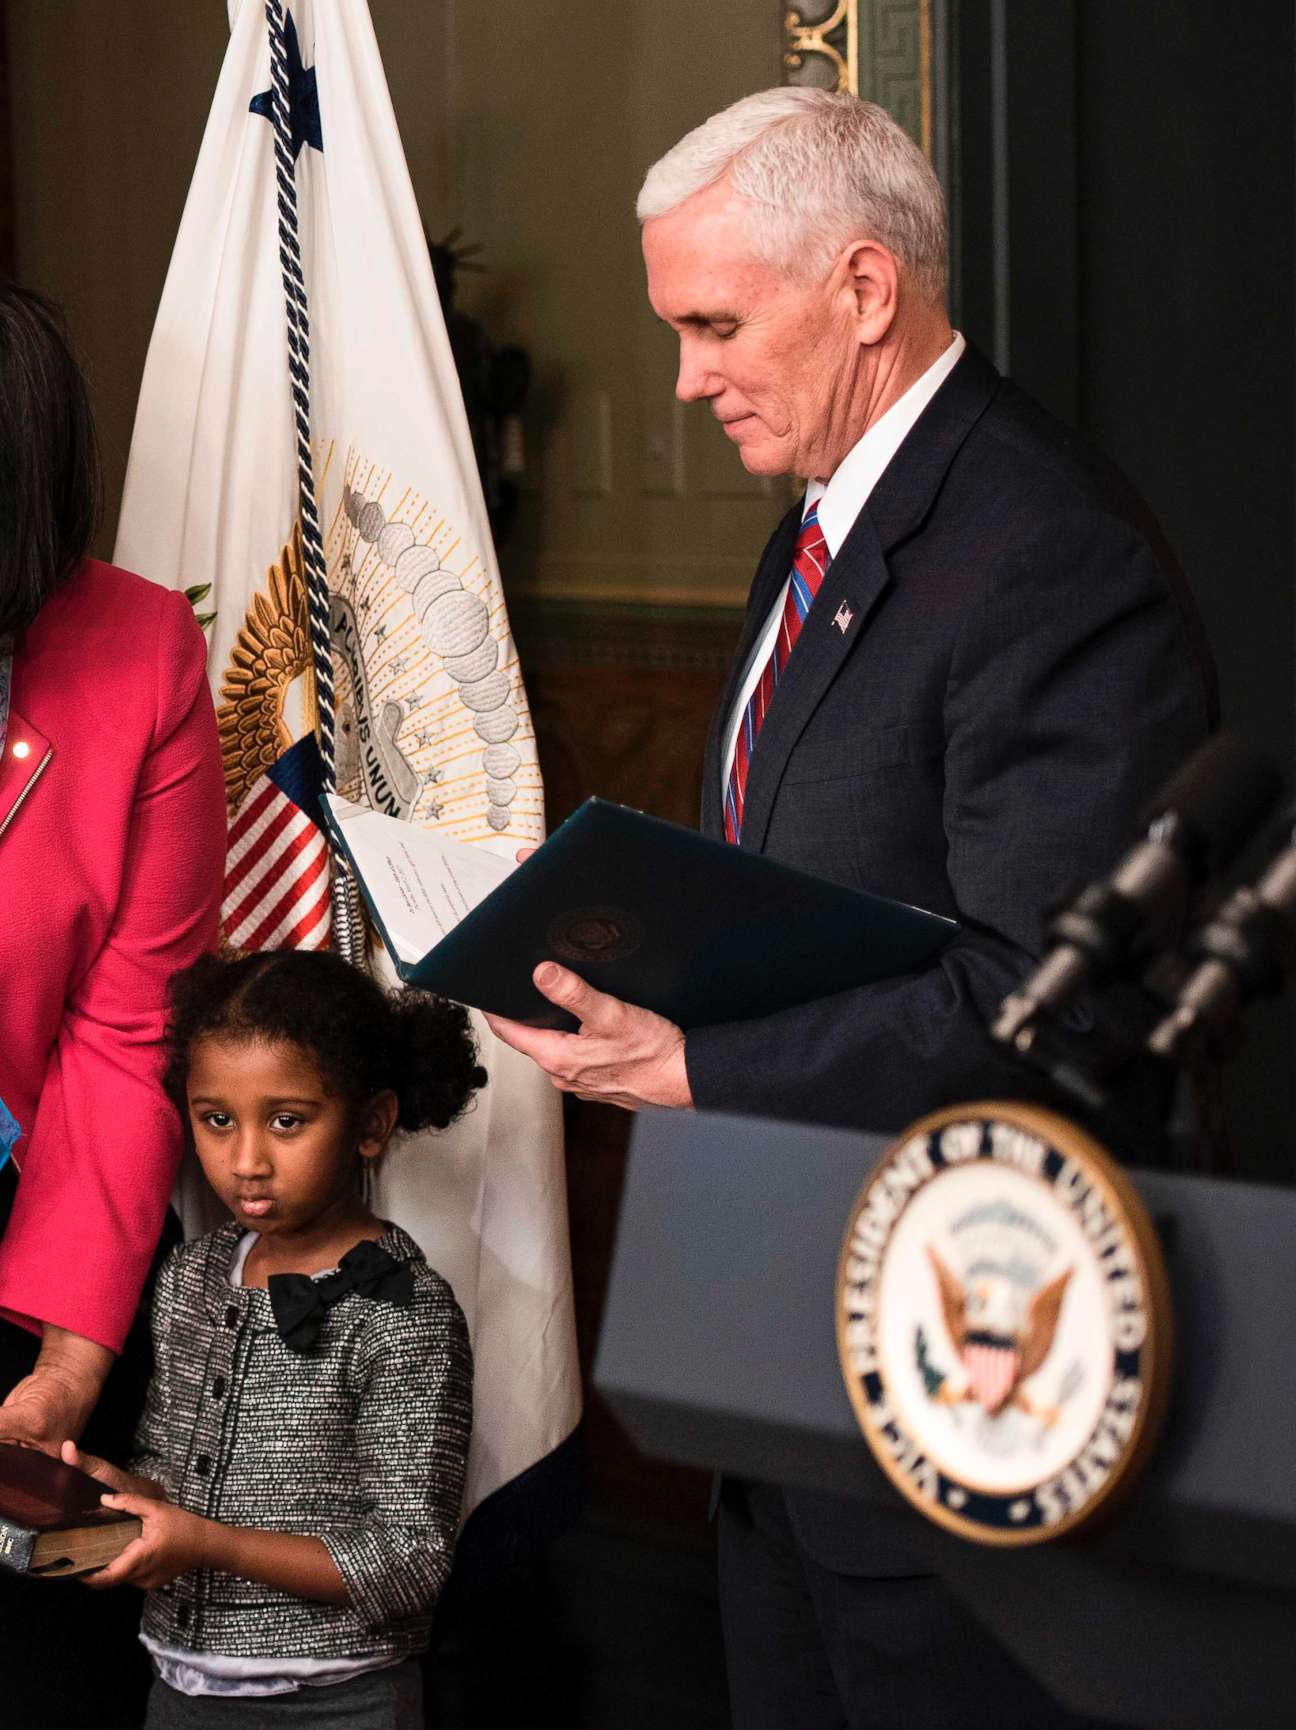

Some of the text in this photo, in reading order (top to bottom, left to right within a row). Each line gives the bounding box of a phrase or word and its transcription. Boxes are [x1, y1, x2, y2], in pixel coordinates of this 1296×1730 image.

[939, 1121, 984, 1162] OF
[844, 1126, 935, 1372] PRESIDENT
[1054, 1156, 1148, 1352] UNITED
[872, 1392, 941, 1503] VICE
[1035, 1374, 1144, 1525] STATES
